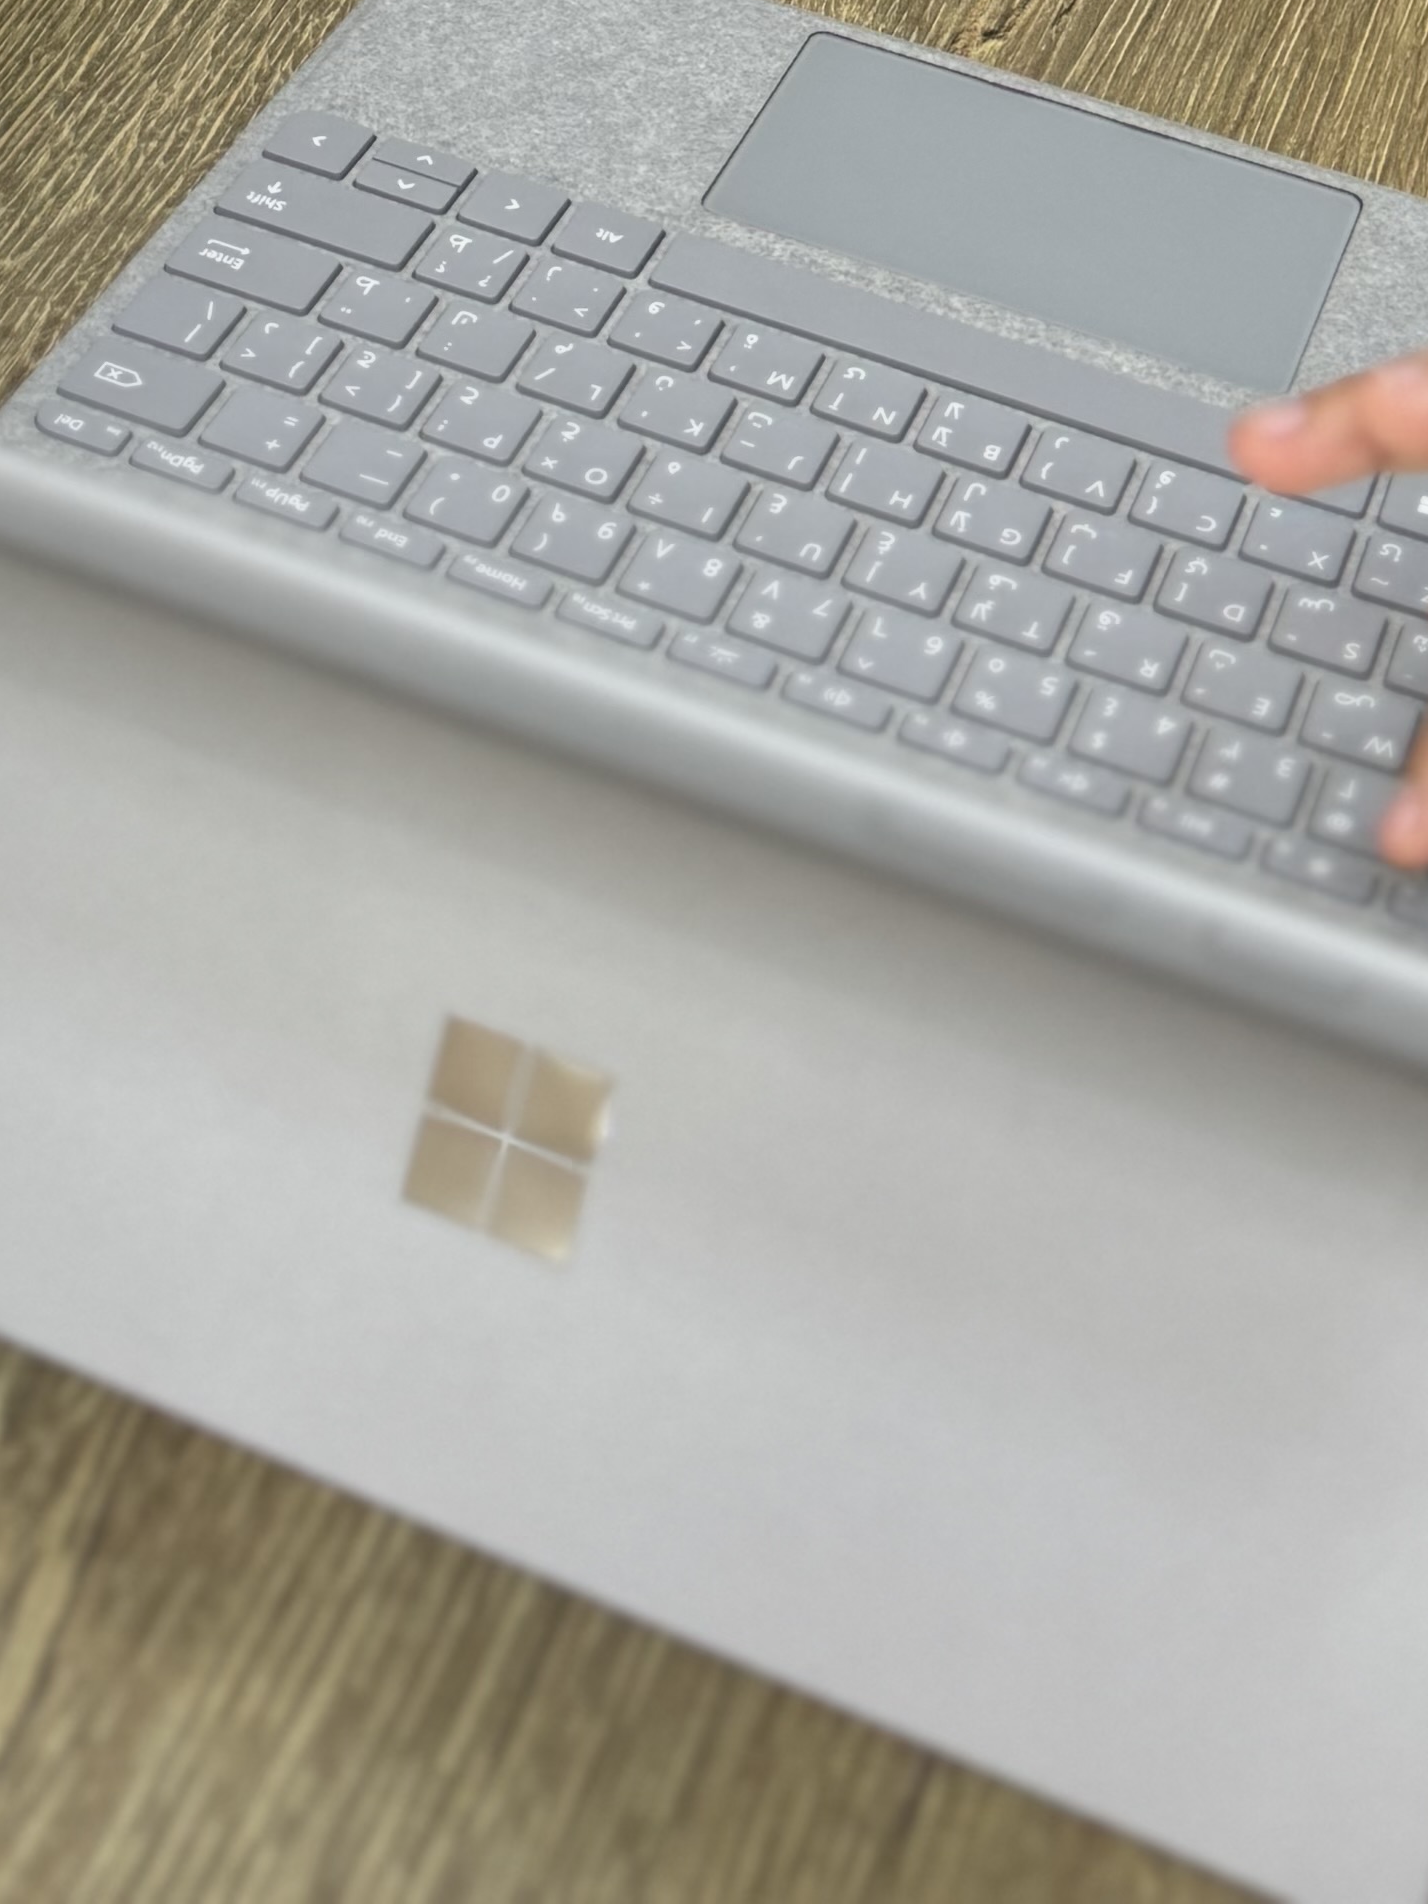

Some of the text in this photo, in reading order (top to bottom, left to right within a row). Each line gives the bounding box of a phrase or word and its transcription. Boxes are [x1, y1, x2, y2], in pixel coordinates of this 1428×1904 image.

[245, 190, 288, 212] Shift
[448, 233, 473, 254] ظ
[595, 227, 624, 244] Alt
[198, 247, 246, 271] Enter
[355, 275, 381, 296] ط
[477, 274, 492, 288] ?
[450, 310, 479, 326] ك
[647, 301, 666, 315] و
[355, 350, 377, 369] ج
[655, 375, 675, 389] ن
[766, 370, 796, 391] M
[459, 385, 480, 406] ح
[54, 413, 85, 431] Del
[871, 406, 897, 426] N
[683, 418, 705, 437] K
[482, 433, 504, 450] P
[160, 449, 205, 475] PgDn
[982, 444, 1003, 462] B
[584, 467, 609, 486] O
[1084, 479, 1105, 498] V
[264, 487, 311, 512] PgUp
[768, 492, 789, 515] ع
[888, 489, 914, 510] H
[596, 521, 618, 540] 9
[1195, 514, 1218, 533] C
[374, 527, 409, 548] End
[999, 527, 1023, 546] G
[798, 542, 823, 562] U
[1307, 550, 1330, 570] X
[475, 563, 527, 591] Home
[702, 558, 724, 578] 8
[1113, 569, 1134, 586] F
[908, 581, 928, 601] Y
[811, 598, 833, 618] 7
[1222, 603, 1246, 623] D
[1297, 596, 1336, 612] س
[751, 611, 772, 630] &
[1021, 620, 1040, 641] T
[923, 635, 945, 656] 6
[1342, 641, 1361, 661] S
[1138, 658, 1160, 679] R
[1039, 675, 1060, 697] 5
[1251, 696, 1272, 718] E
[1333, 691, 1377, 709] ص
[1155, 716, 1177, 736] 4
[1363, 735, 1394, 758] W
[1275, 756, 1296, 779] 3
